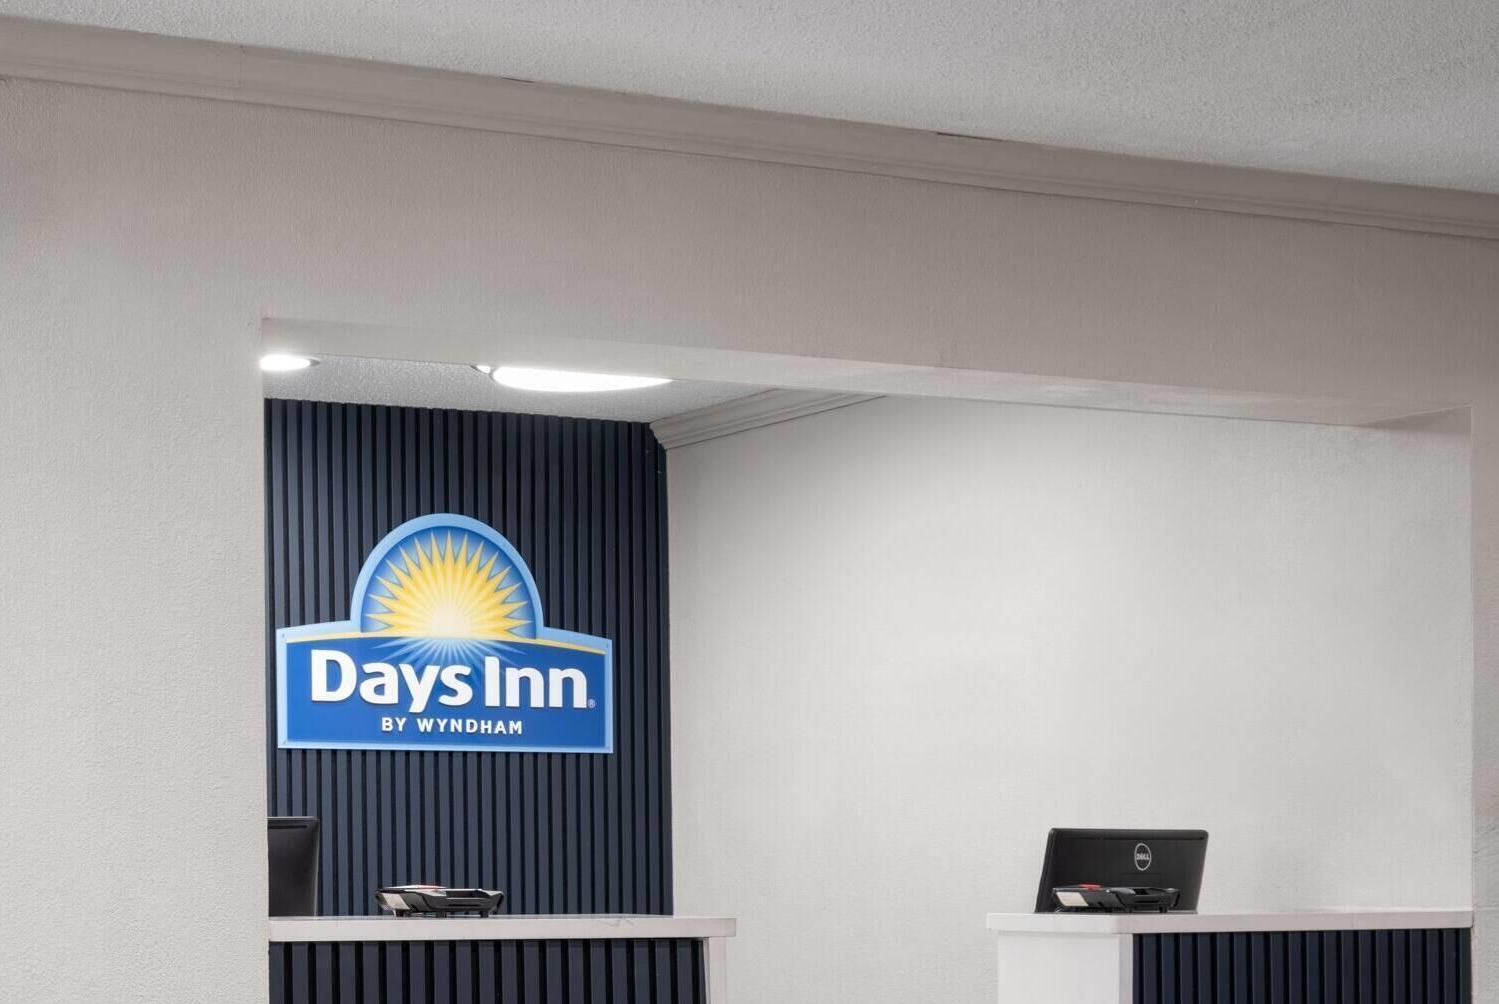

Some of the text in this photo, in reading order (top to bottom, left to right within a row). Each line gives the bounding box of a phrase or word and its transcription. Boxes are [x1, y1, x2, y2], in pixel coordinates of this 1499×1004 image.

[310, 649, 473, 713] Days
[381, 717, 523, 735] BY WYNDHAM
